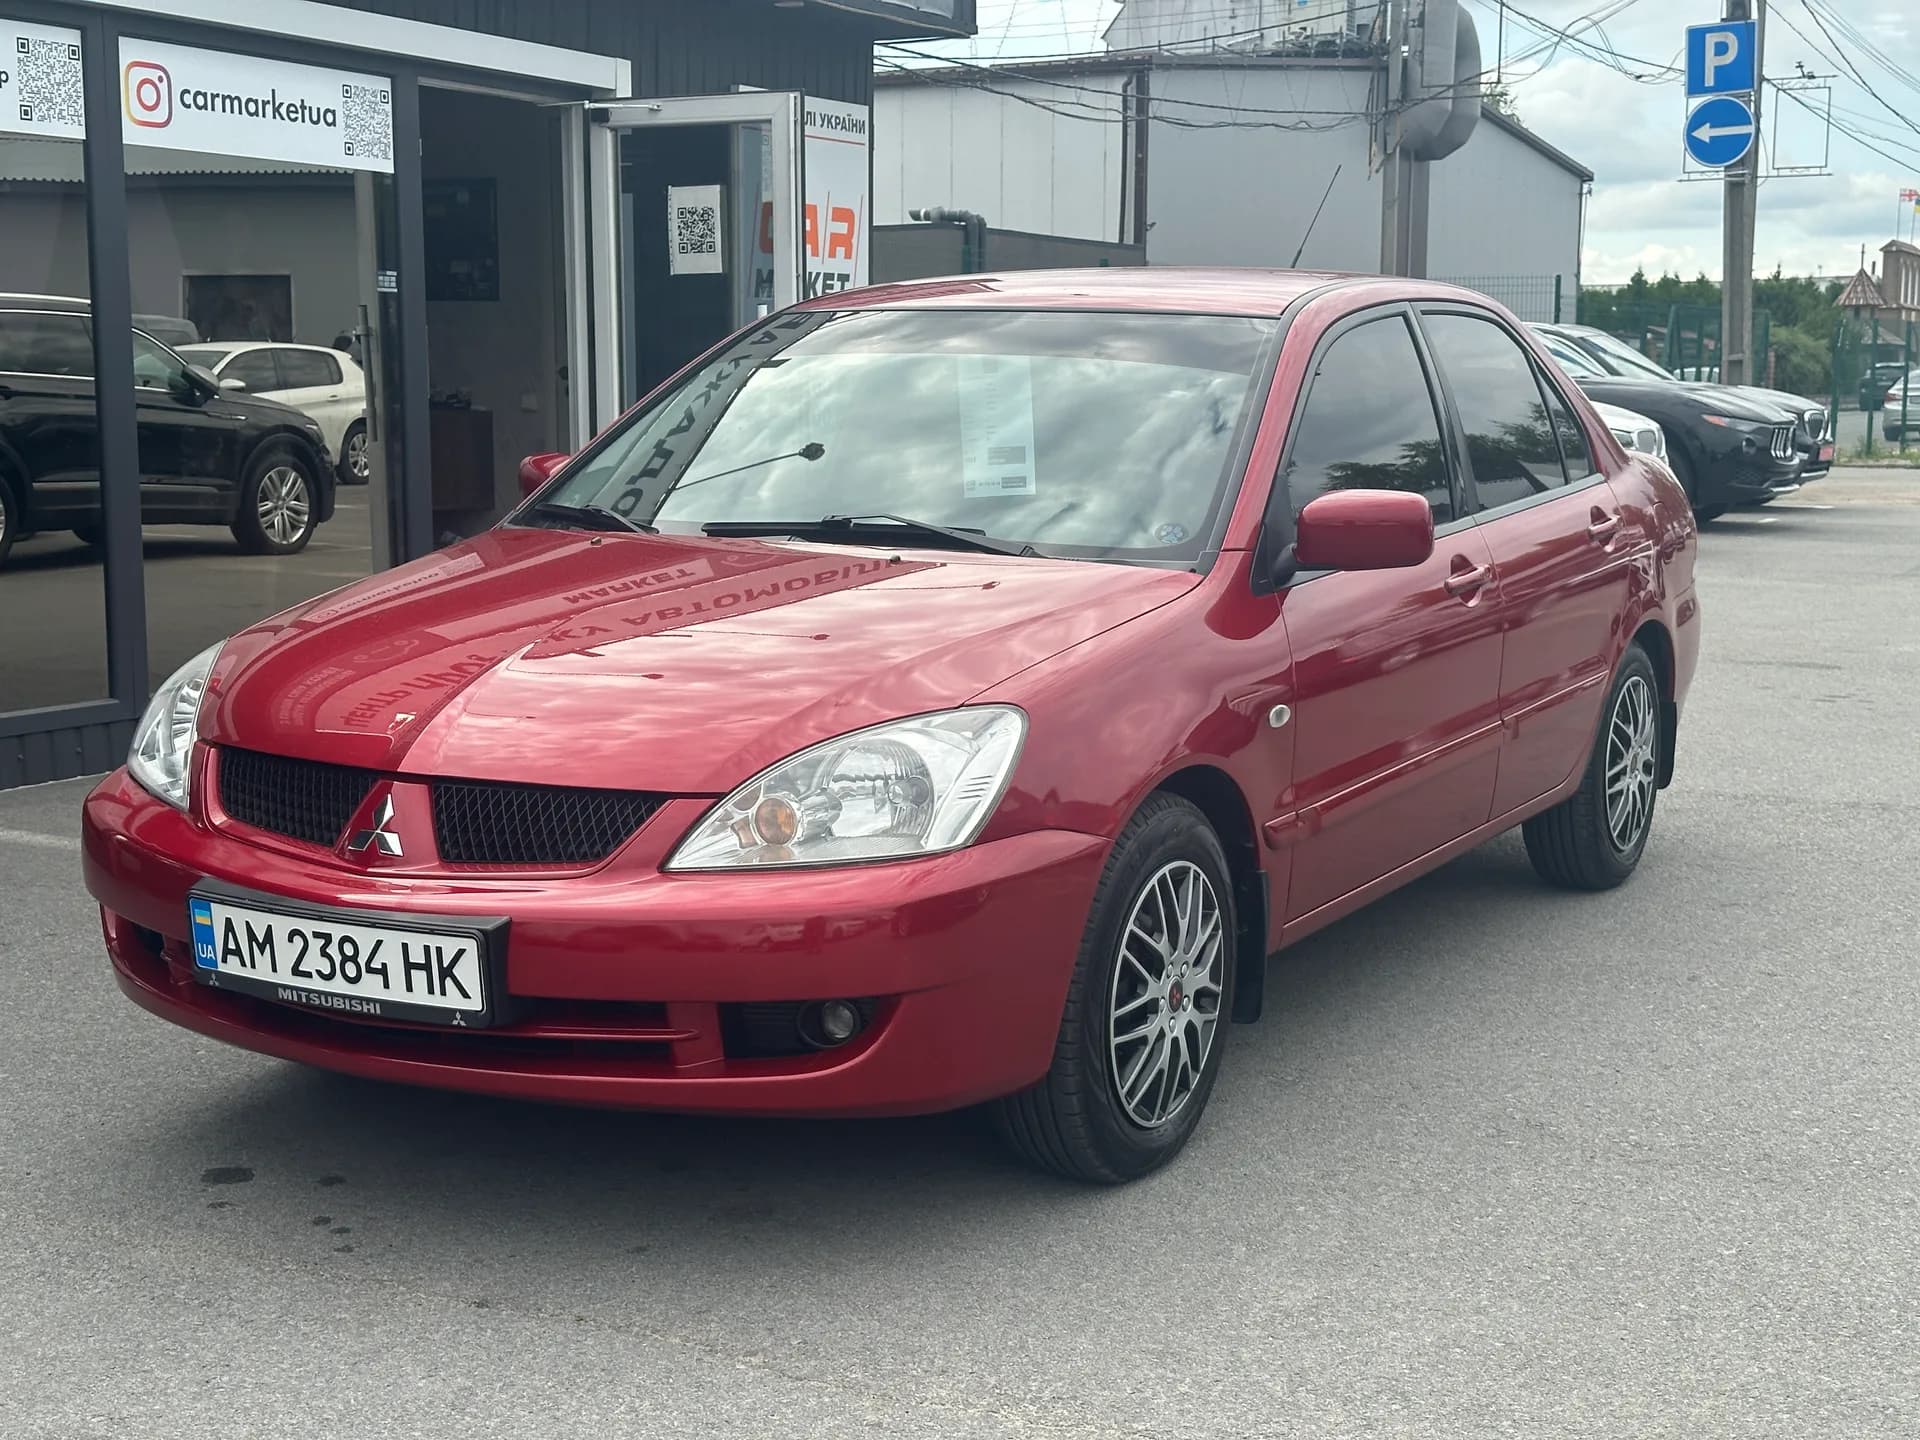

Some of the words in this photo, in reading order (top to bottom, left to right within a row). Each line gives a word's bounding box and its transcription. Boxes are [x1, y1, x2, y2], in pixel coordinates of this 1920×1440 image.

[1704, 31, 1738, 87] P
[180, 88, 337, 128] carmarketua
[820, 113, 865, 135] УКРАЇНИ
[198, 942, 216, 962] UA
[221, 916, 278, 974] AM
[287, 928, 390, 990] 2384
[400, 942, 472, 1000] HK
[278, 987, 381, 1015] MITSUBISHI
